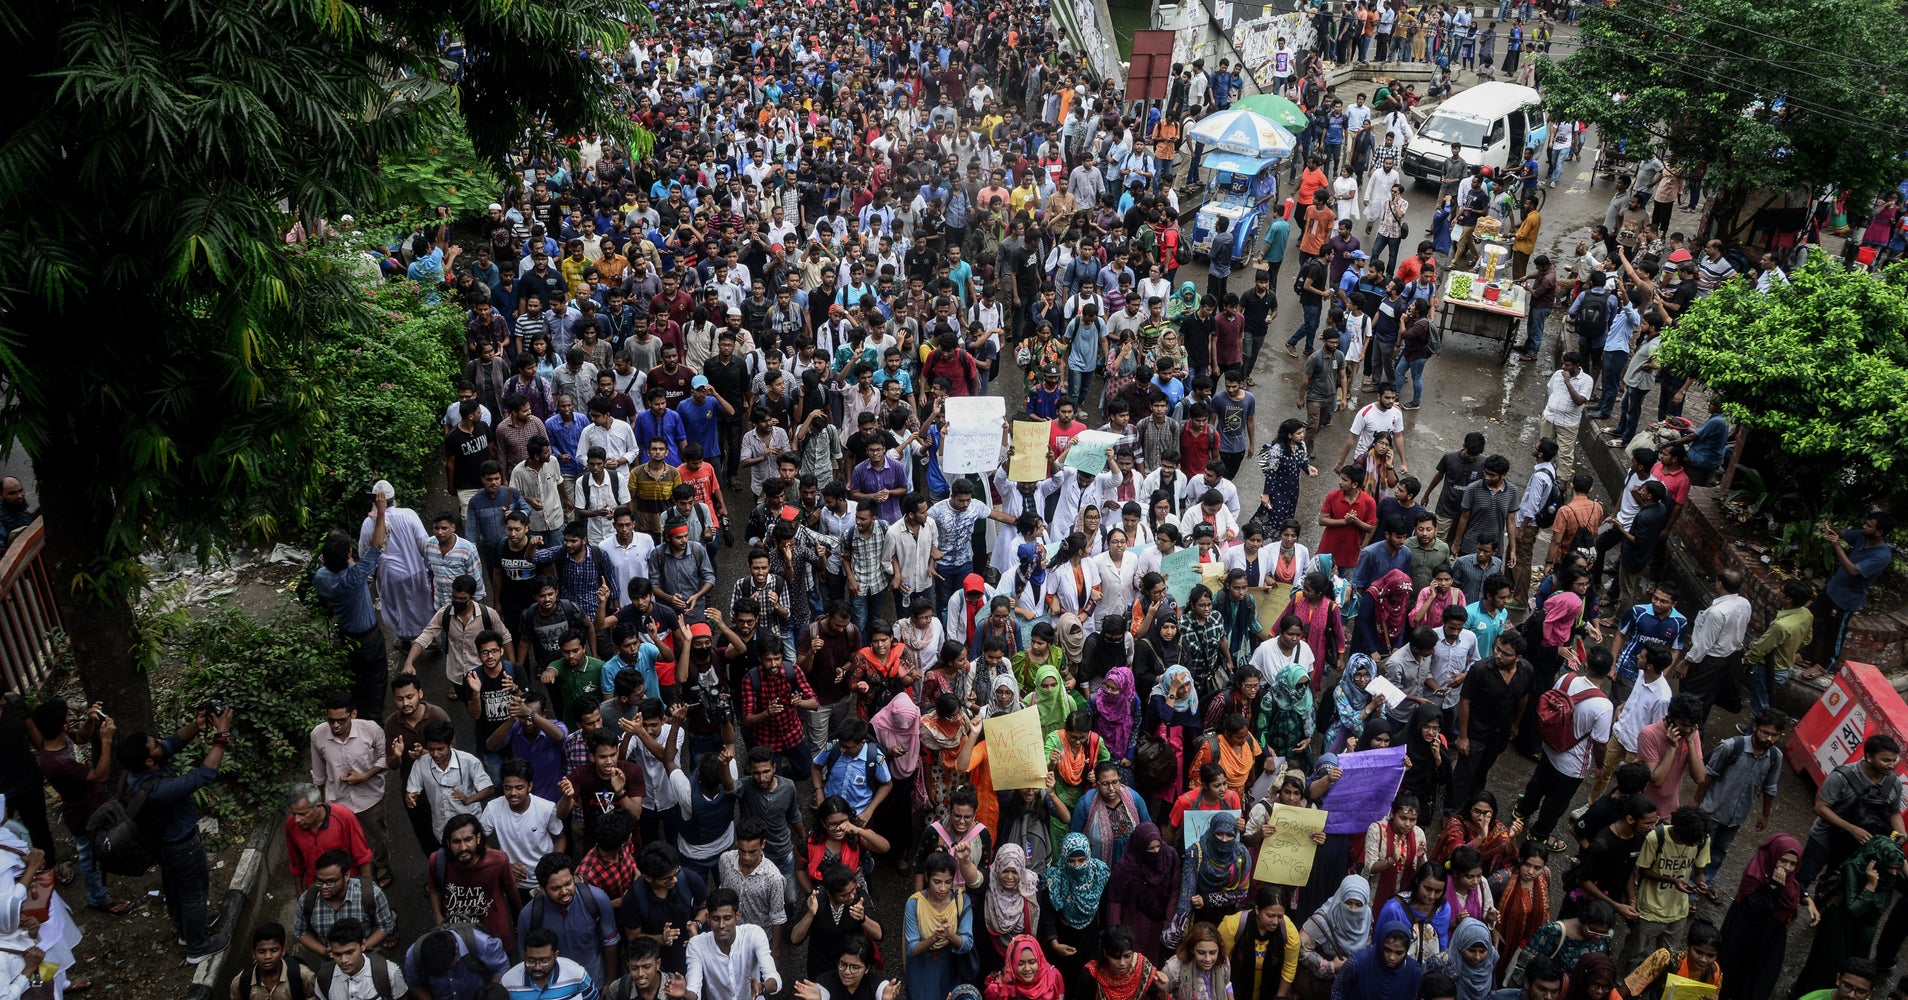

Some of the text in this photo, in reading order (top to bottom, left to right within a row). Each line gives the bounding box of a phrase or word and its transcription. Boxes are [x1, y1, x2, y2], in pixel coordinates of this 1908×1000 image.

[461, 434, 488, 456] CALVIN
[991, 724, 1034, 748] WE
[994, 741, 1041, 764] WANT
[457, 886, 482, 897] EAT
